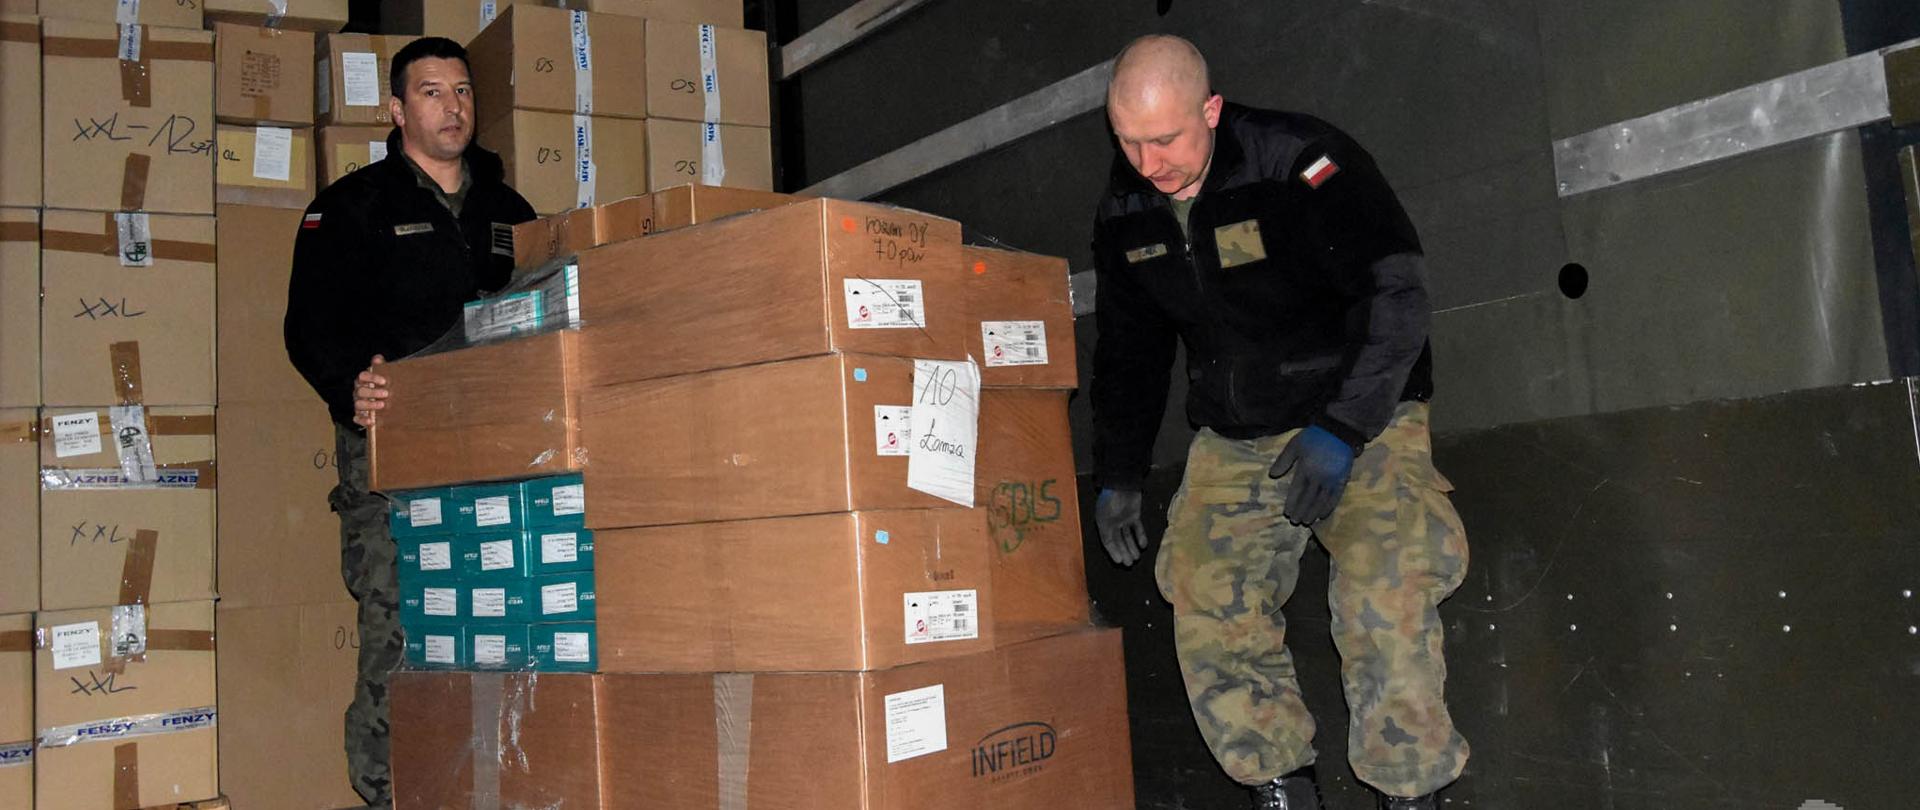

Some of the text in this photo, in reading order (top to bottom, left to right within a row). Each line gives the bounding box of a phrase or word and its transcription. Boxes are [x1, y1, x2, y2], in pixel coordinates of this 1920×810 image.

[670, 79, 696, 94] OS
[537, 147, 562, 164] OS
[873, 238, 897, 260] 70
[73, 297, 146, 320] XXL
[920, 365, 957, 406] 10
[57, 417, 93, 427] FENZY
[71, 521, 126, 547] XXL
[71, 669, 137, 697] XXL
[77, 721, 138, 737] FENZY
[161, 711, 216, 727] FENZY
[971, 732, 1056, 778] INFIELD
